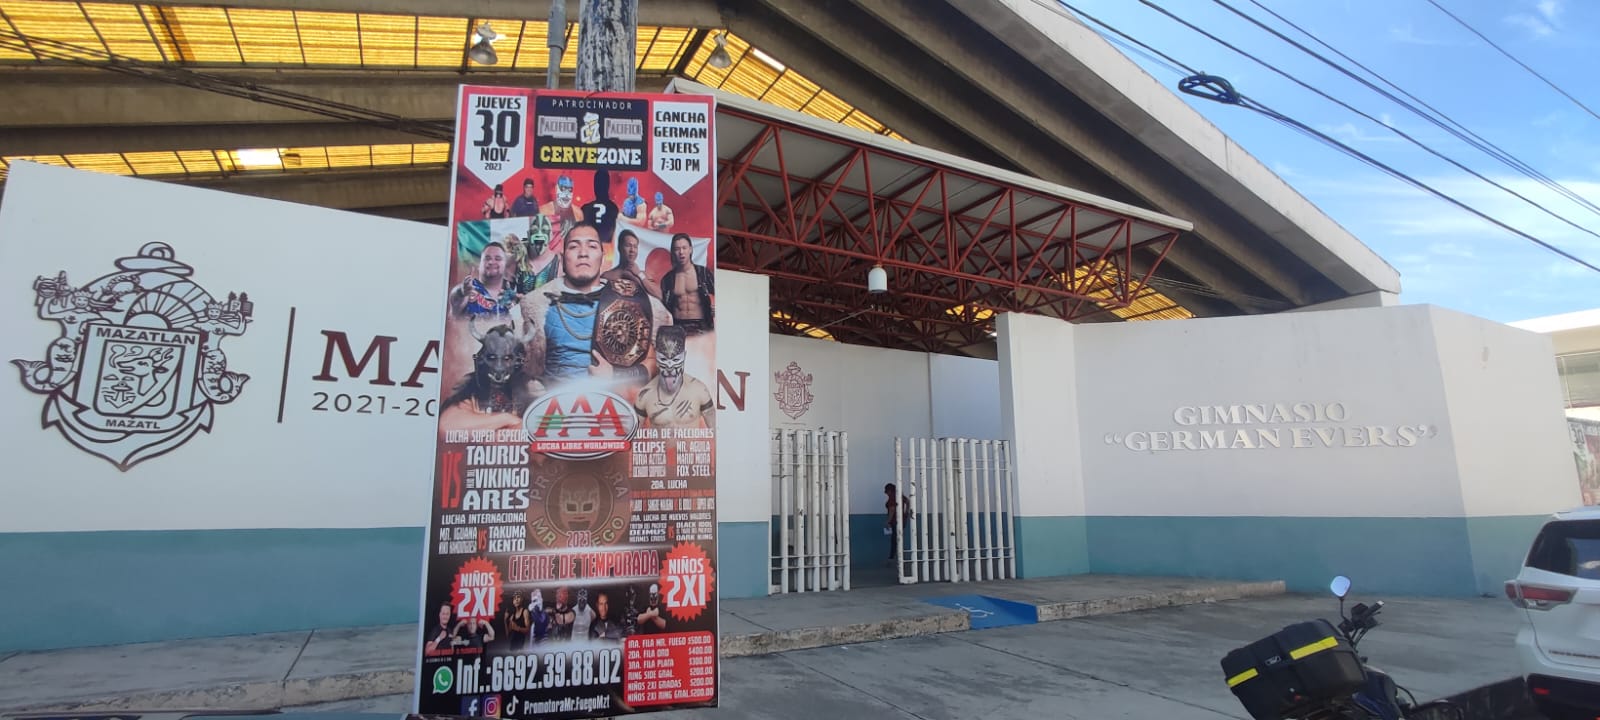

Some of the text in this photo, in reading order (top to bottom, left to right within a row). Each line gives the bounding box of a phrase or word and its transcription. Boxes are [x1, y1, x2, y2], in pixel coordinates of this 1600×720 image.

[475, 96, 521, 109] JUEVES
[552, 99, 632, 110] PATROCINADOR
[655, 111, 706, 123] CANCHA
[473, 109, 521, 148] 30
[654, 127, 707, 139] GERMAN
[480, 147, 510, 162] NOV.
[661, 142, 700, 154] EVERS
[540, 146, 641, 165] CERVEZONE
[484, 163, 502, 171] 2023
[661, 158, 700, 172] 7:30 PM
[96, 327, 196, 345] MAZATLAN
[312, 391, 437, 417] 2021-20
[534, 395, 627, 437] AAA
[1173, 401, 1351, 426] GIMNASIO
[105, 419, 160, 429] MAZATL
[445, 429, 469, 443] LUCHA
[471, 429, 495, 443] SUPER
[661, 428, 673, 439] DE
[673, 428, 714, 438] FACCIONES
[561, 442, 582, 450] LIBRE
[633, 441, 666, 452] ECLIPSE
[467, 445, 529, 465] TAURUS
[476, 468, 530, 488] VIKINGO
[677, 465, 689, 477] FOX
[692, 465, 711, 476] STEEL
[441, 451, 463, 508] VS
[667, 480, 688, 489] LUCHA
[463, 489, 530, 511] ARES
[442, 512, 527, 525] LUCHA INTERNACIONAL
[489, 525, 526, 539] TAKUMA
[567, 530, 592, 548] 2023
[478, 529, 487, 550] VS
[489, 539, 526, 553] KENTO
[508, 550, 659, 582] CIERRE DE TEMPORADA
[669, 556, 704, 574] NIÑOS
[460, 571, 494, 587] NIÑOS
[642, 639, 654, 648] FILA
[669, 637, 686, 646] FUEGO
[688, 635, 711, 645] $500.00
[643, 650, 655, 658] FILA
[644, 660, 655, 669] FILA
[644, 670, 656, 679] SIDE
[628, 681, 645, 691] NIÑOS
[627, 692, 645, 702] NIÑOS
